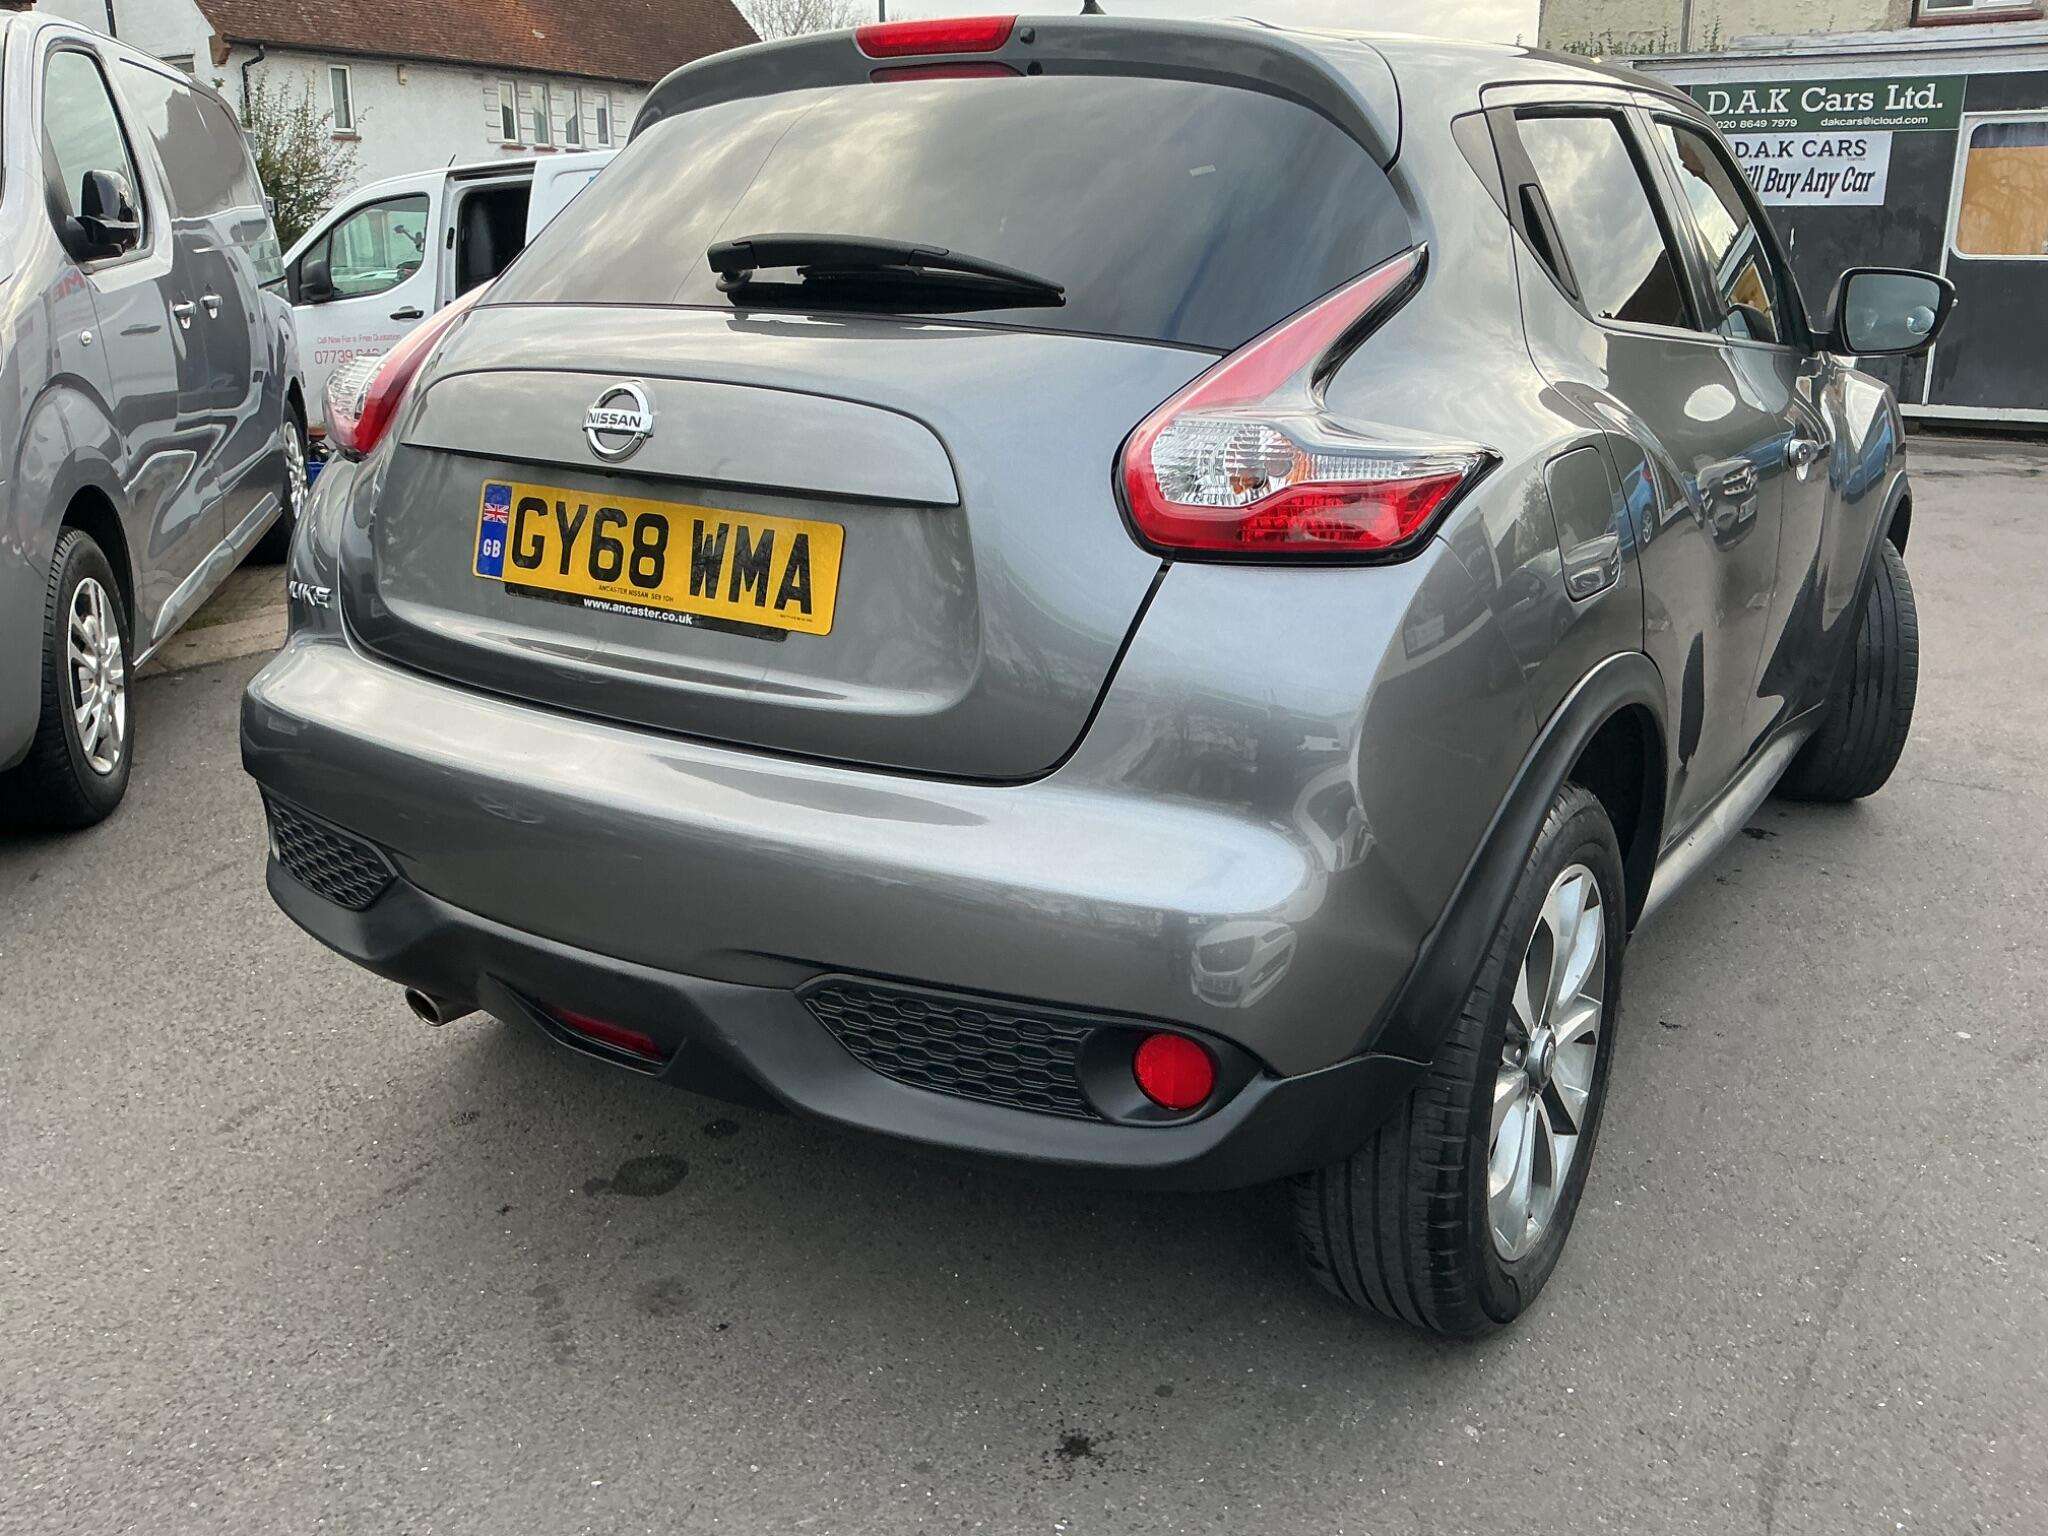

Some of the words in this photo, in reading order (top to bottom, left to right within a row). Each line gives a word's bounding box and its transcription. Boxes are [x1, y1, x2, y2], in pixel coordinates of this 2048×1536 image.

[1707, 88, 1791, 115] D.A.K
[1801, 87, 1874, 112] Cars
[1885, 83, 1943, 110] Ltd.
[1716, 120, 1737, 129] 020
[1740, 119, 1768, 128] 8649
[1771, 118, 1798, 128] 7979
[1820, 116, 1929, 126] dakcars@icloud.com
[1734, 140, 1794, 158] D.A.K
[1802, 139, 1867, 157] CARS
[1763, 167, 1801, 199] Buy
[1800, 167, 1840, 198] Any
[1841, 166, 1876, 192] Car
[587, 412, 642, 428] NISSAN
[483, 538, 501, 558] GB
[511, 496, 670, 589] GY68
[689, 519, 813, 615] WMA
[628, 589, 649, 599] NISSAN
[583, 598, 693, 625] www.ancaster.co.uk
